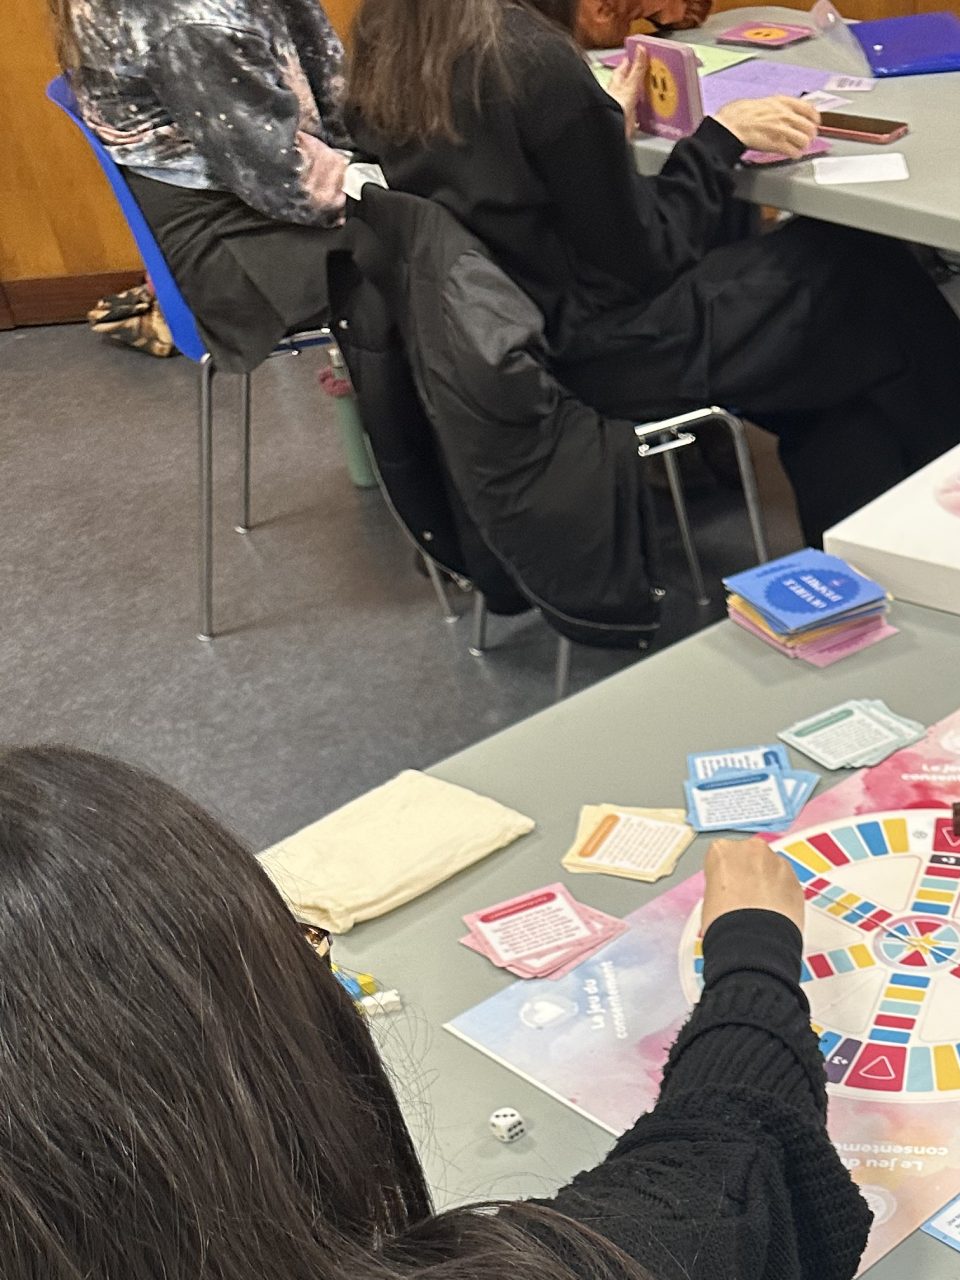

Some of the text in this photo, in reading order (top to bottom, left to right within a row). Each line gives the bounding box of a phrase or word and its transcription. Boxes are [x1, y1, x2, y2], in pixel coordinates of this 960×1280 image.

[583, 979, 598, 995] du
[600, 960, 629, 1039] consentement
[591, 1015, 605, 1030] Le
[867, 1158, 898, 1171] jeu
[901, 1160, 923, 1171] Le
